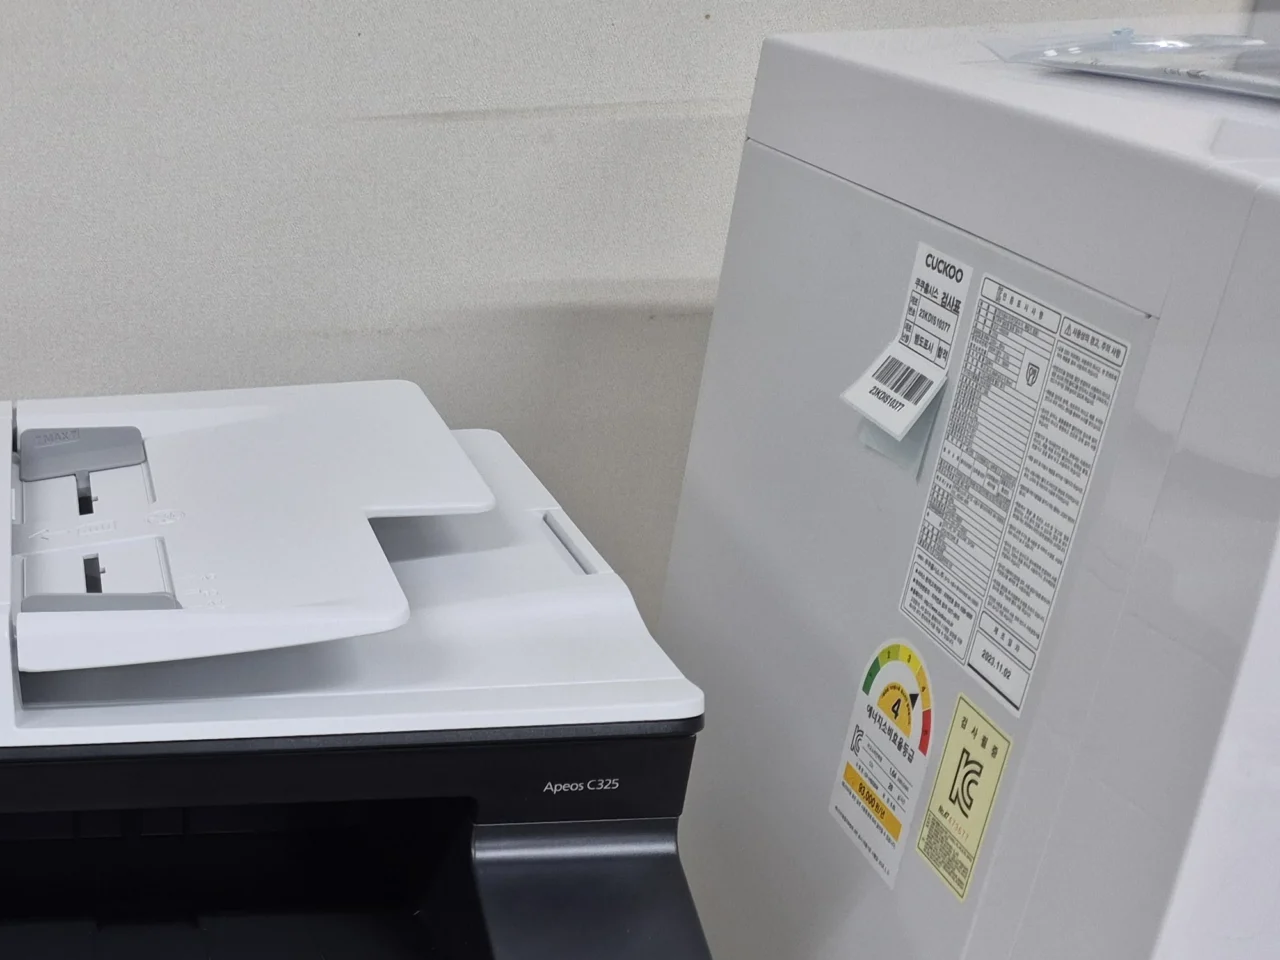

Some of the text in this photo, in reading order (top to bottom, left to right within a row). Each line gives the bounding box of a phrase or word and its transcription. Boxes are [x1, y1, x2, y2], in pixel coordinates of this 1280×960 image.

[925, 253, 964, 283] CUCKOO
[914, 277, 962, 314] 쿠쿠홈시스 검사표
[868, 385, 905, 412] 23KDIS10377
[44, 431, 69, 443] MAX
[981, 649, 1012, 680] 2023.11.02
[890, 697, 902, 720] 4
[866, 704, 915, 764] 에너지소비효율등급
[543, 778, 620, 795] Apeos C325
